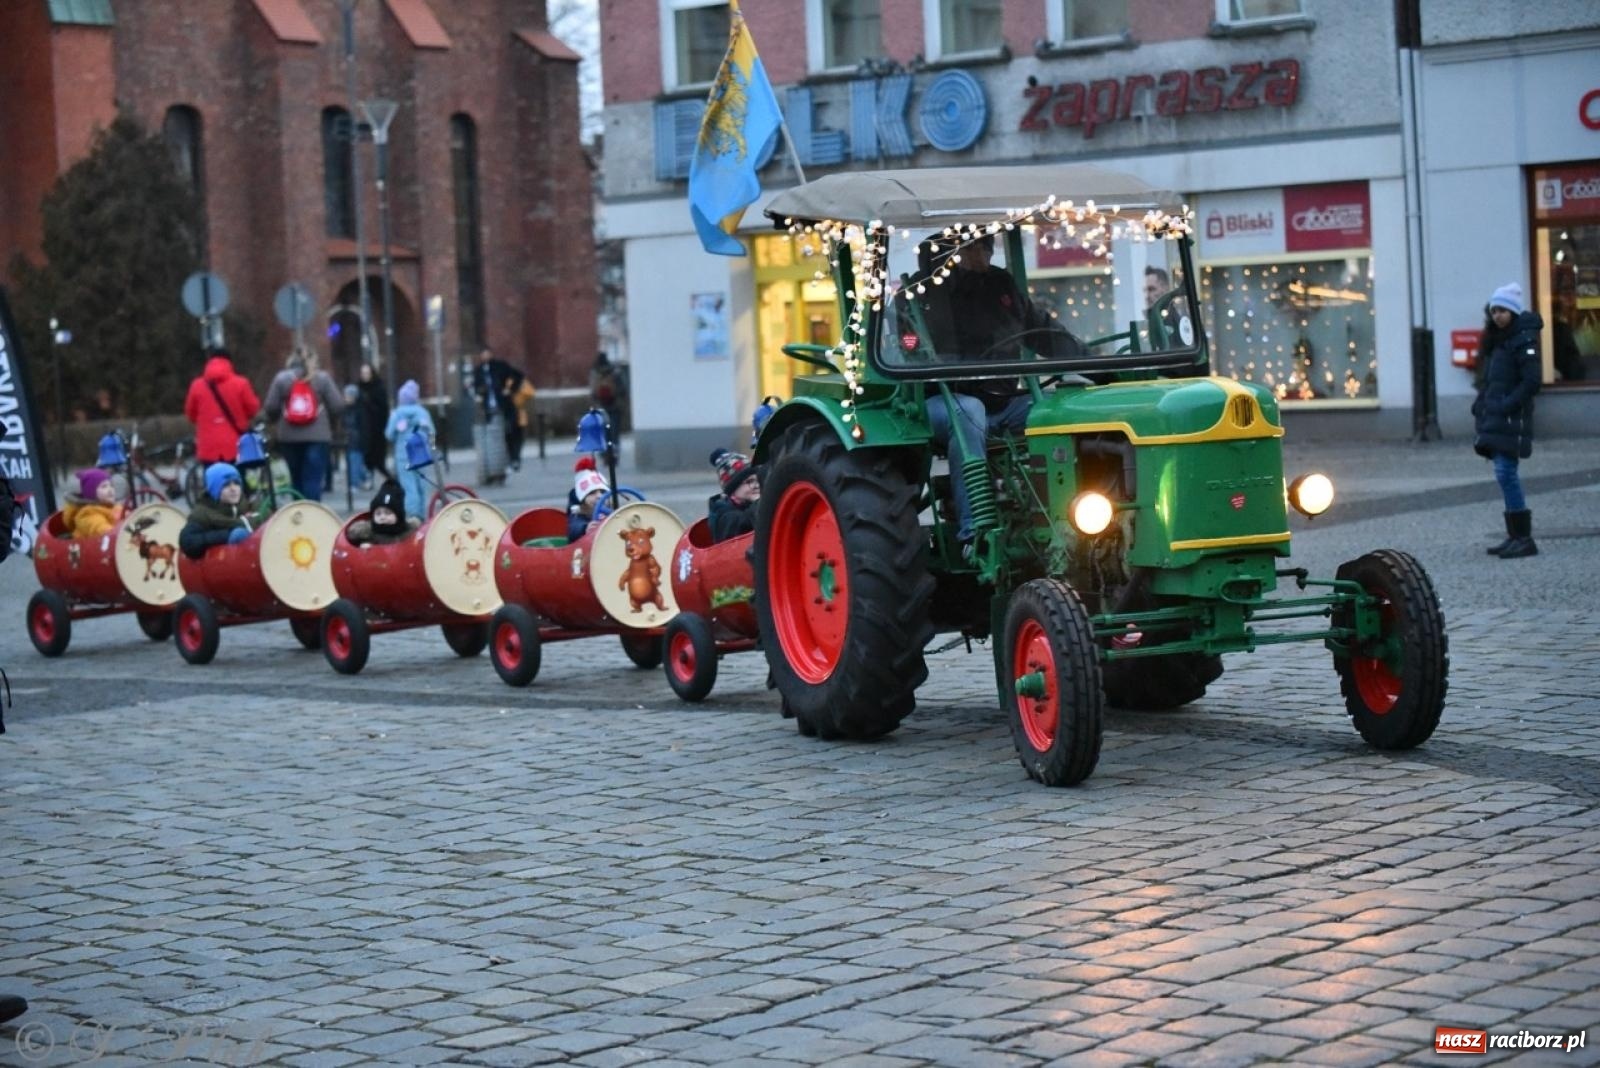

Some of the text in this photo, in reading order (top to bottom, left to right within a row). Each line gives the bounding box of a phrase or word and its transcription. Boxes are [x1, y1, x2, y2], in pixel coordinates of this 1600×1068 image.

[655, 58, 1300, 182] BLKO zaprasza
[1226, 211, 1274, 233] Bliski
